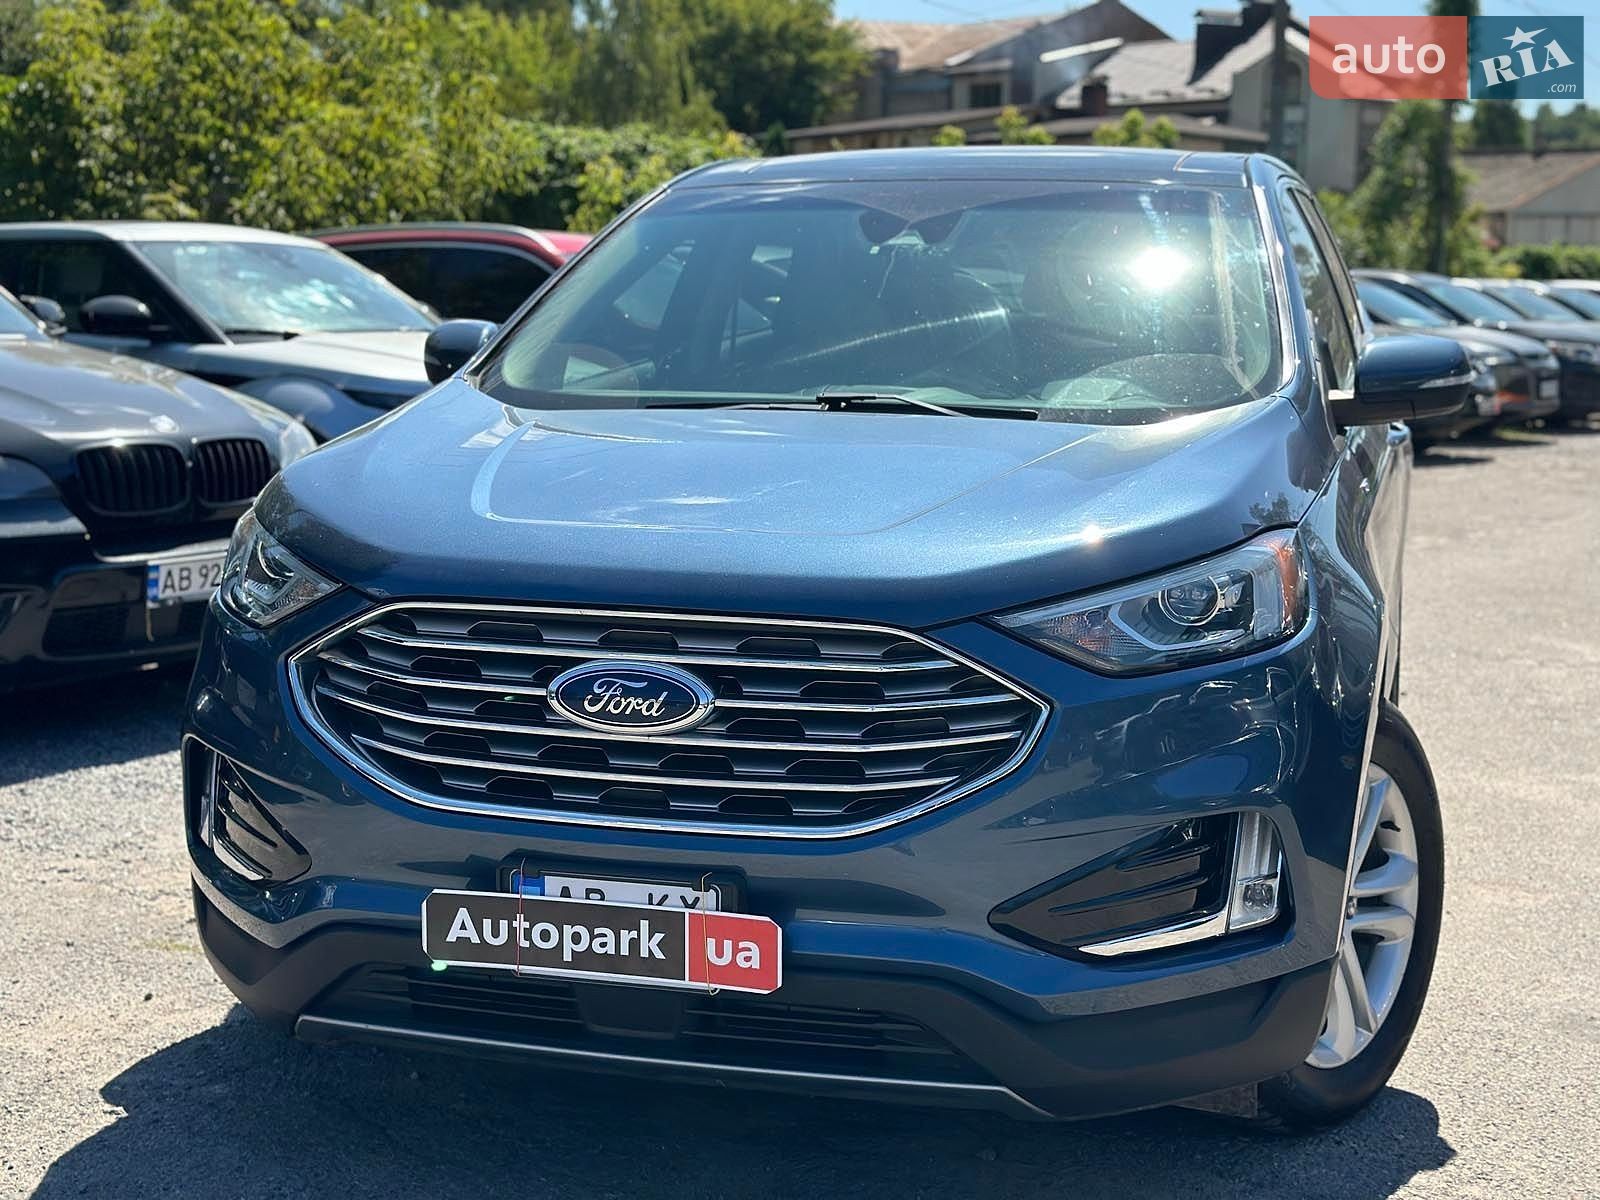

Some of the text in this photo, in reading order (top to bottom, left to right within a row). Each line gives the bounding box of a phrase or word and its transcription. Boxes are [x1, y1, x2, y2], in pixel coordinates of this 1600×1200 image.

[162, 567, 192, 595] AB
[583, 677, 669, 717] Ford
[445, 907, 761, 969] Autopark ua
